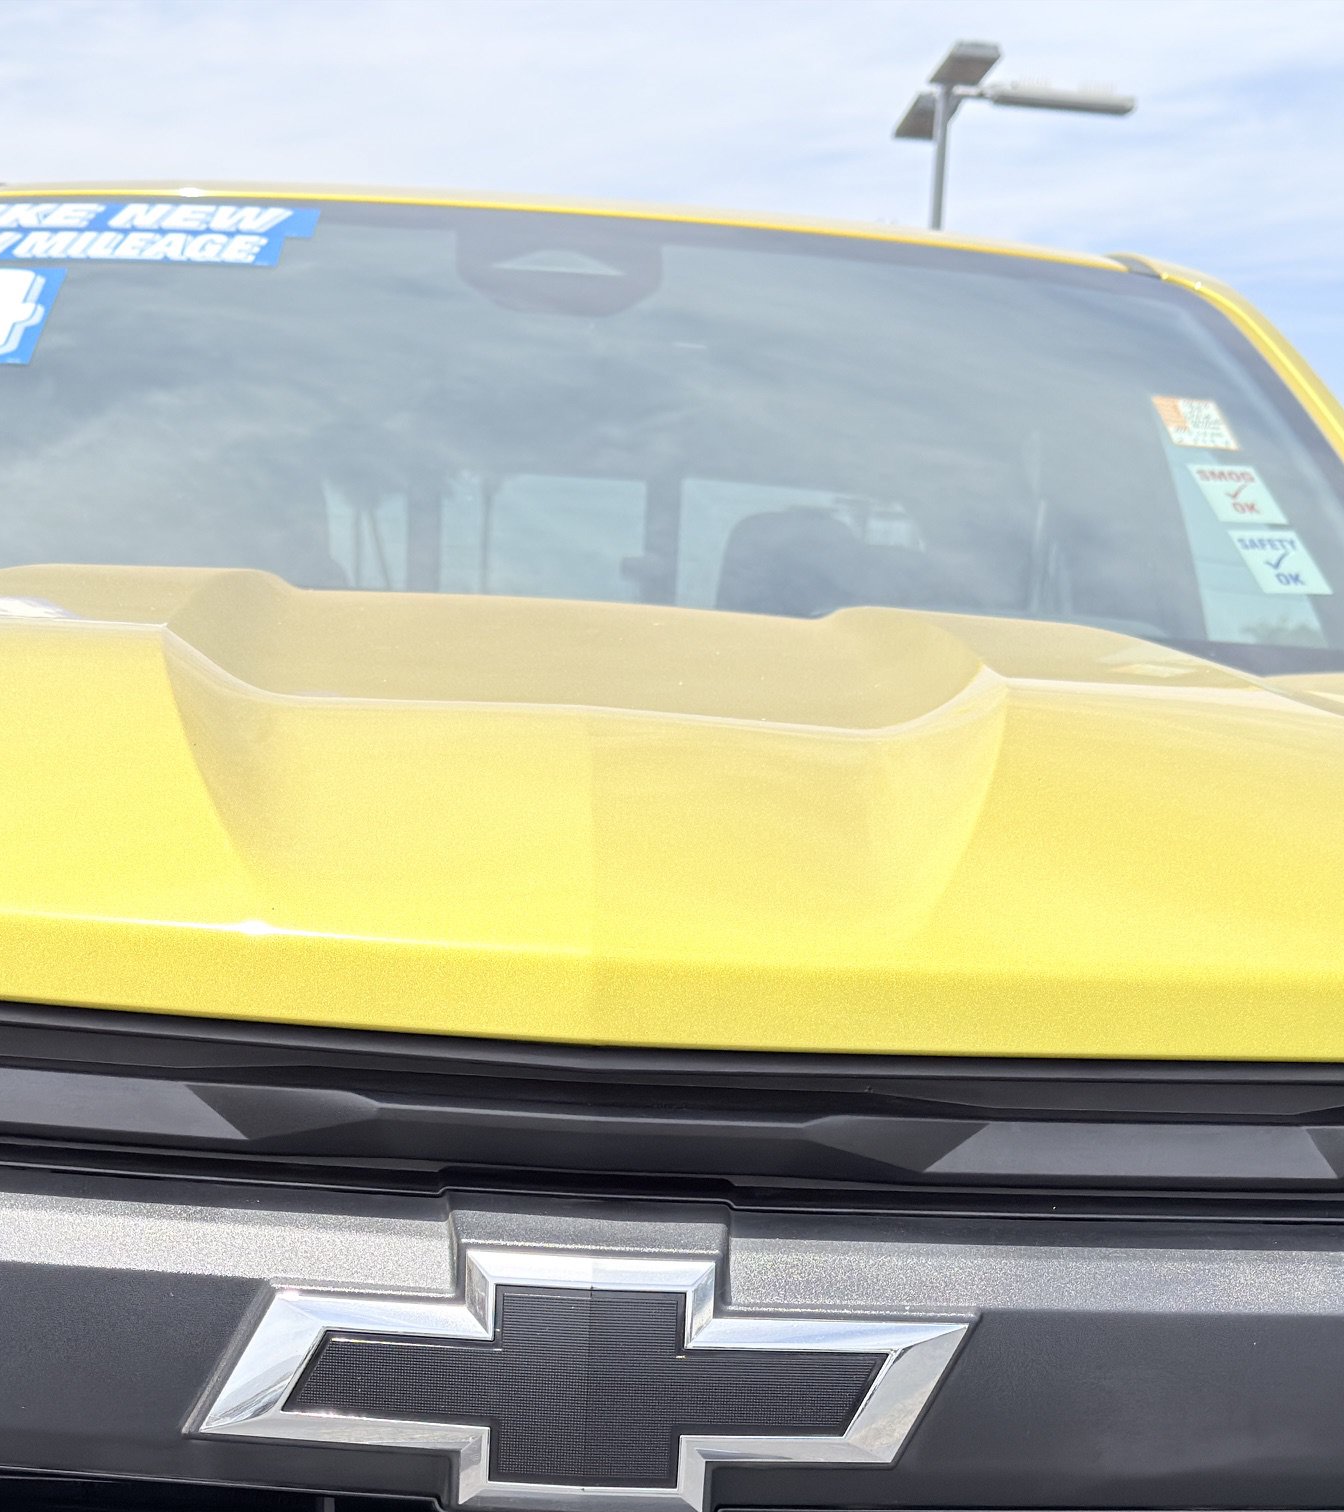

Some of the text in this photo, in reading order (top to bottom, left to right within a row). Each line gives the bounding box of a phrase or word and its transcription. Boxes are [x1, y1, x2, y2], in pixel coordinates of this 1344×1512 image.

[107, 202, 292, 232] NEW
[11, 233, 268, 264] MILEAGE
[1196, 468, 1255, 483] SMOG
[1232, 501, 1260, 515] OK
[1237, 538, 1296, 551] SAFETY
[1275, 572, 1306, 587] OK
